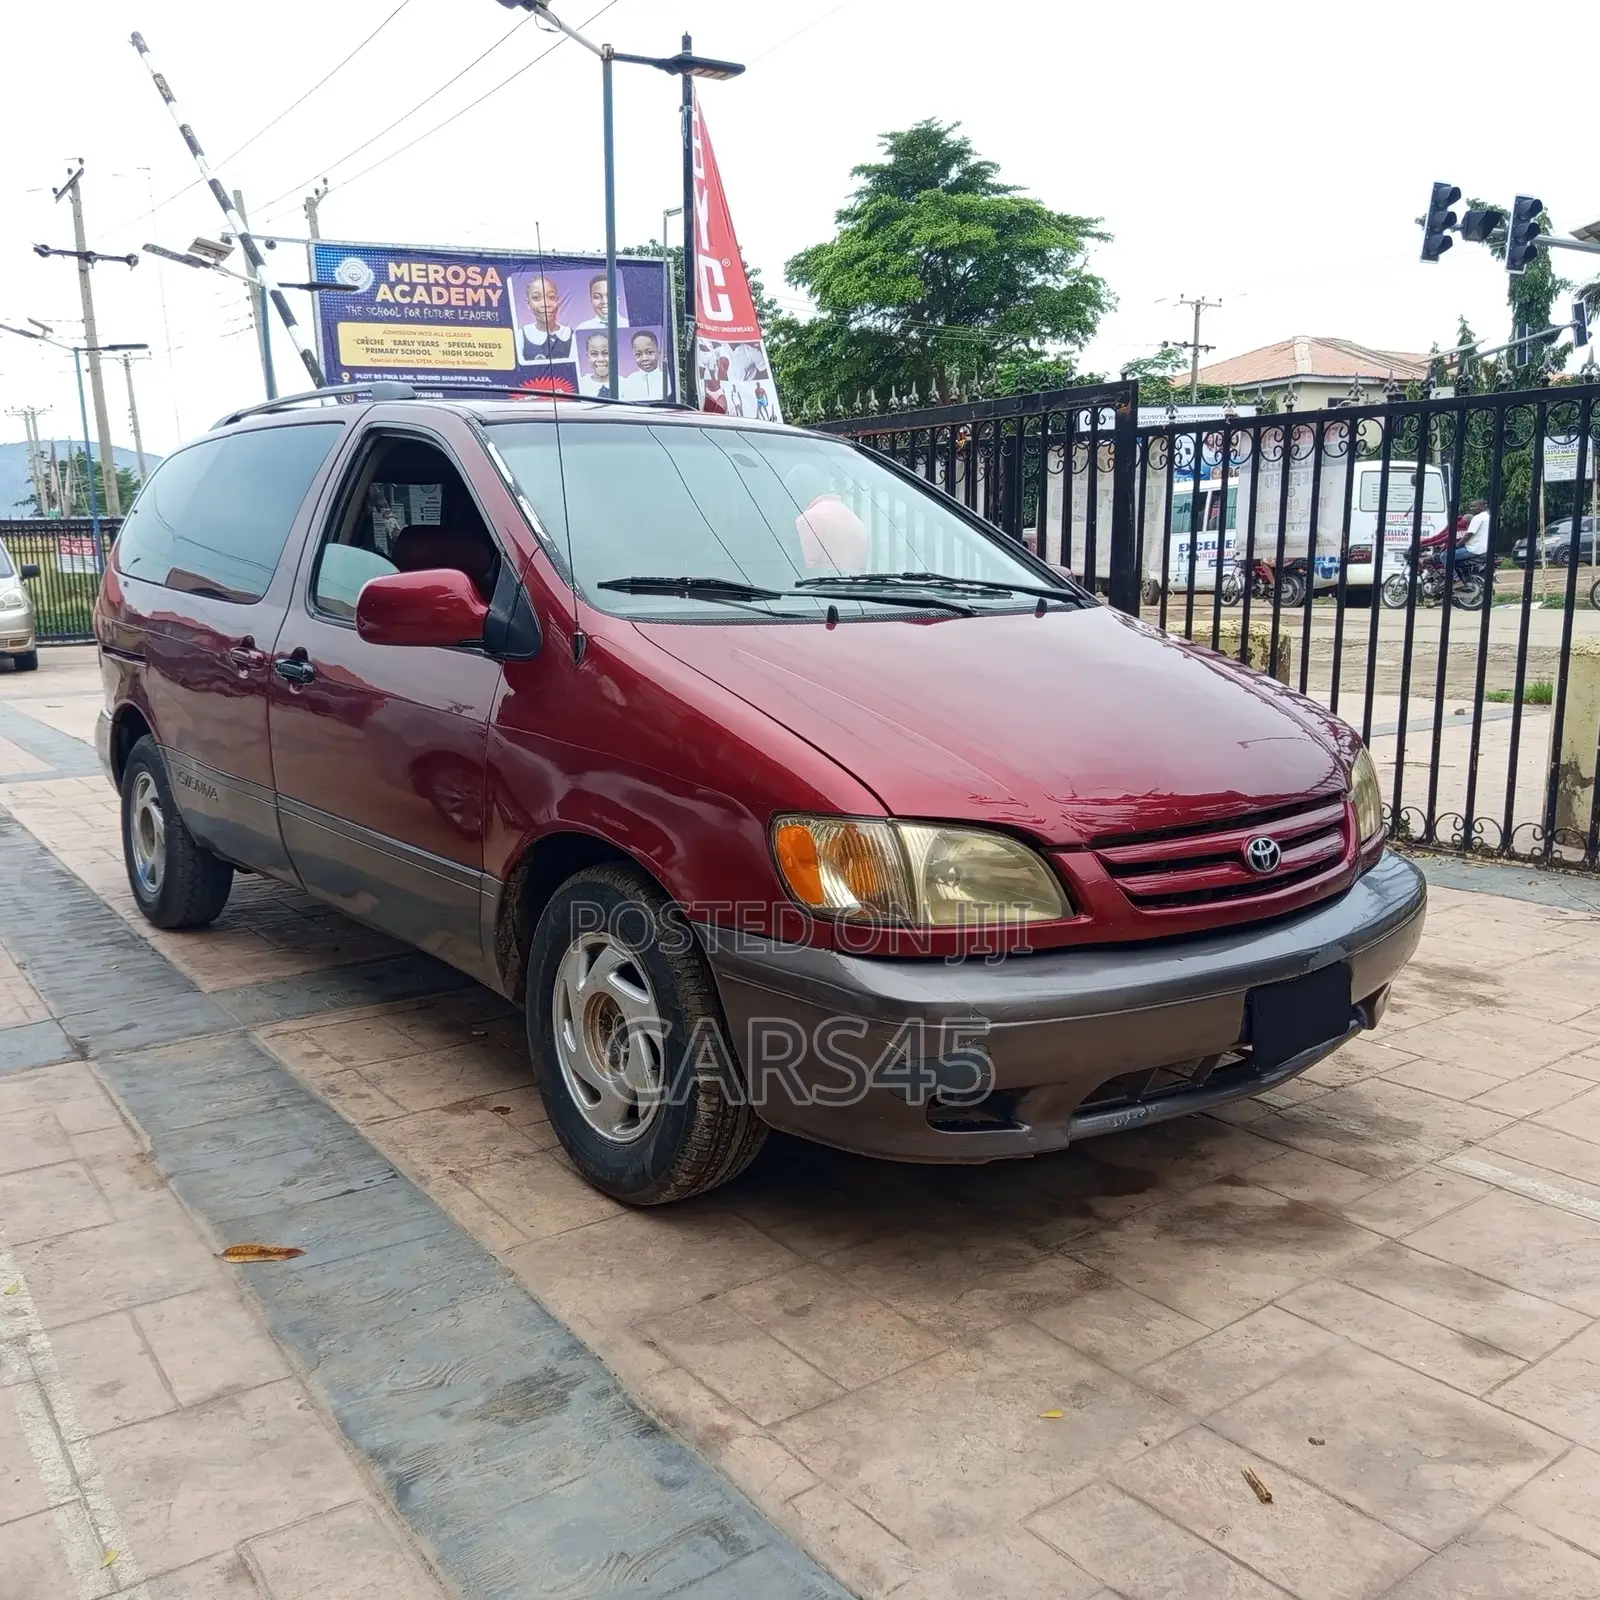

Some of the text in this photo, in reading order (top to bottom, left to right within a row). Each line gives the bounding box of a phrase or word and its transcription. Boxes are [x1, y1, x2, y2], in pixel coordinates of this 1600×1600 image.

[387, 262, 502, 286] MEROSA
[375, 284, 503, 307] ACADEMY
[345, 305, 500, 322] THE SCHOOL FOR FUTURE LEADERS!
[365, 347, 432, 356] PRIMARY SCHOOL
[447, 341, 502, 350] SPECIAL NEEDS
[464, 350, 494, 358] SCHOOL
[176, 771, 219, 802] SIENNA
